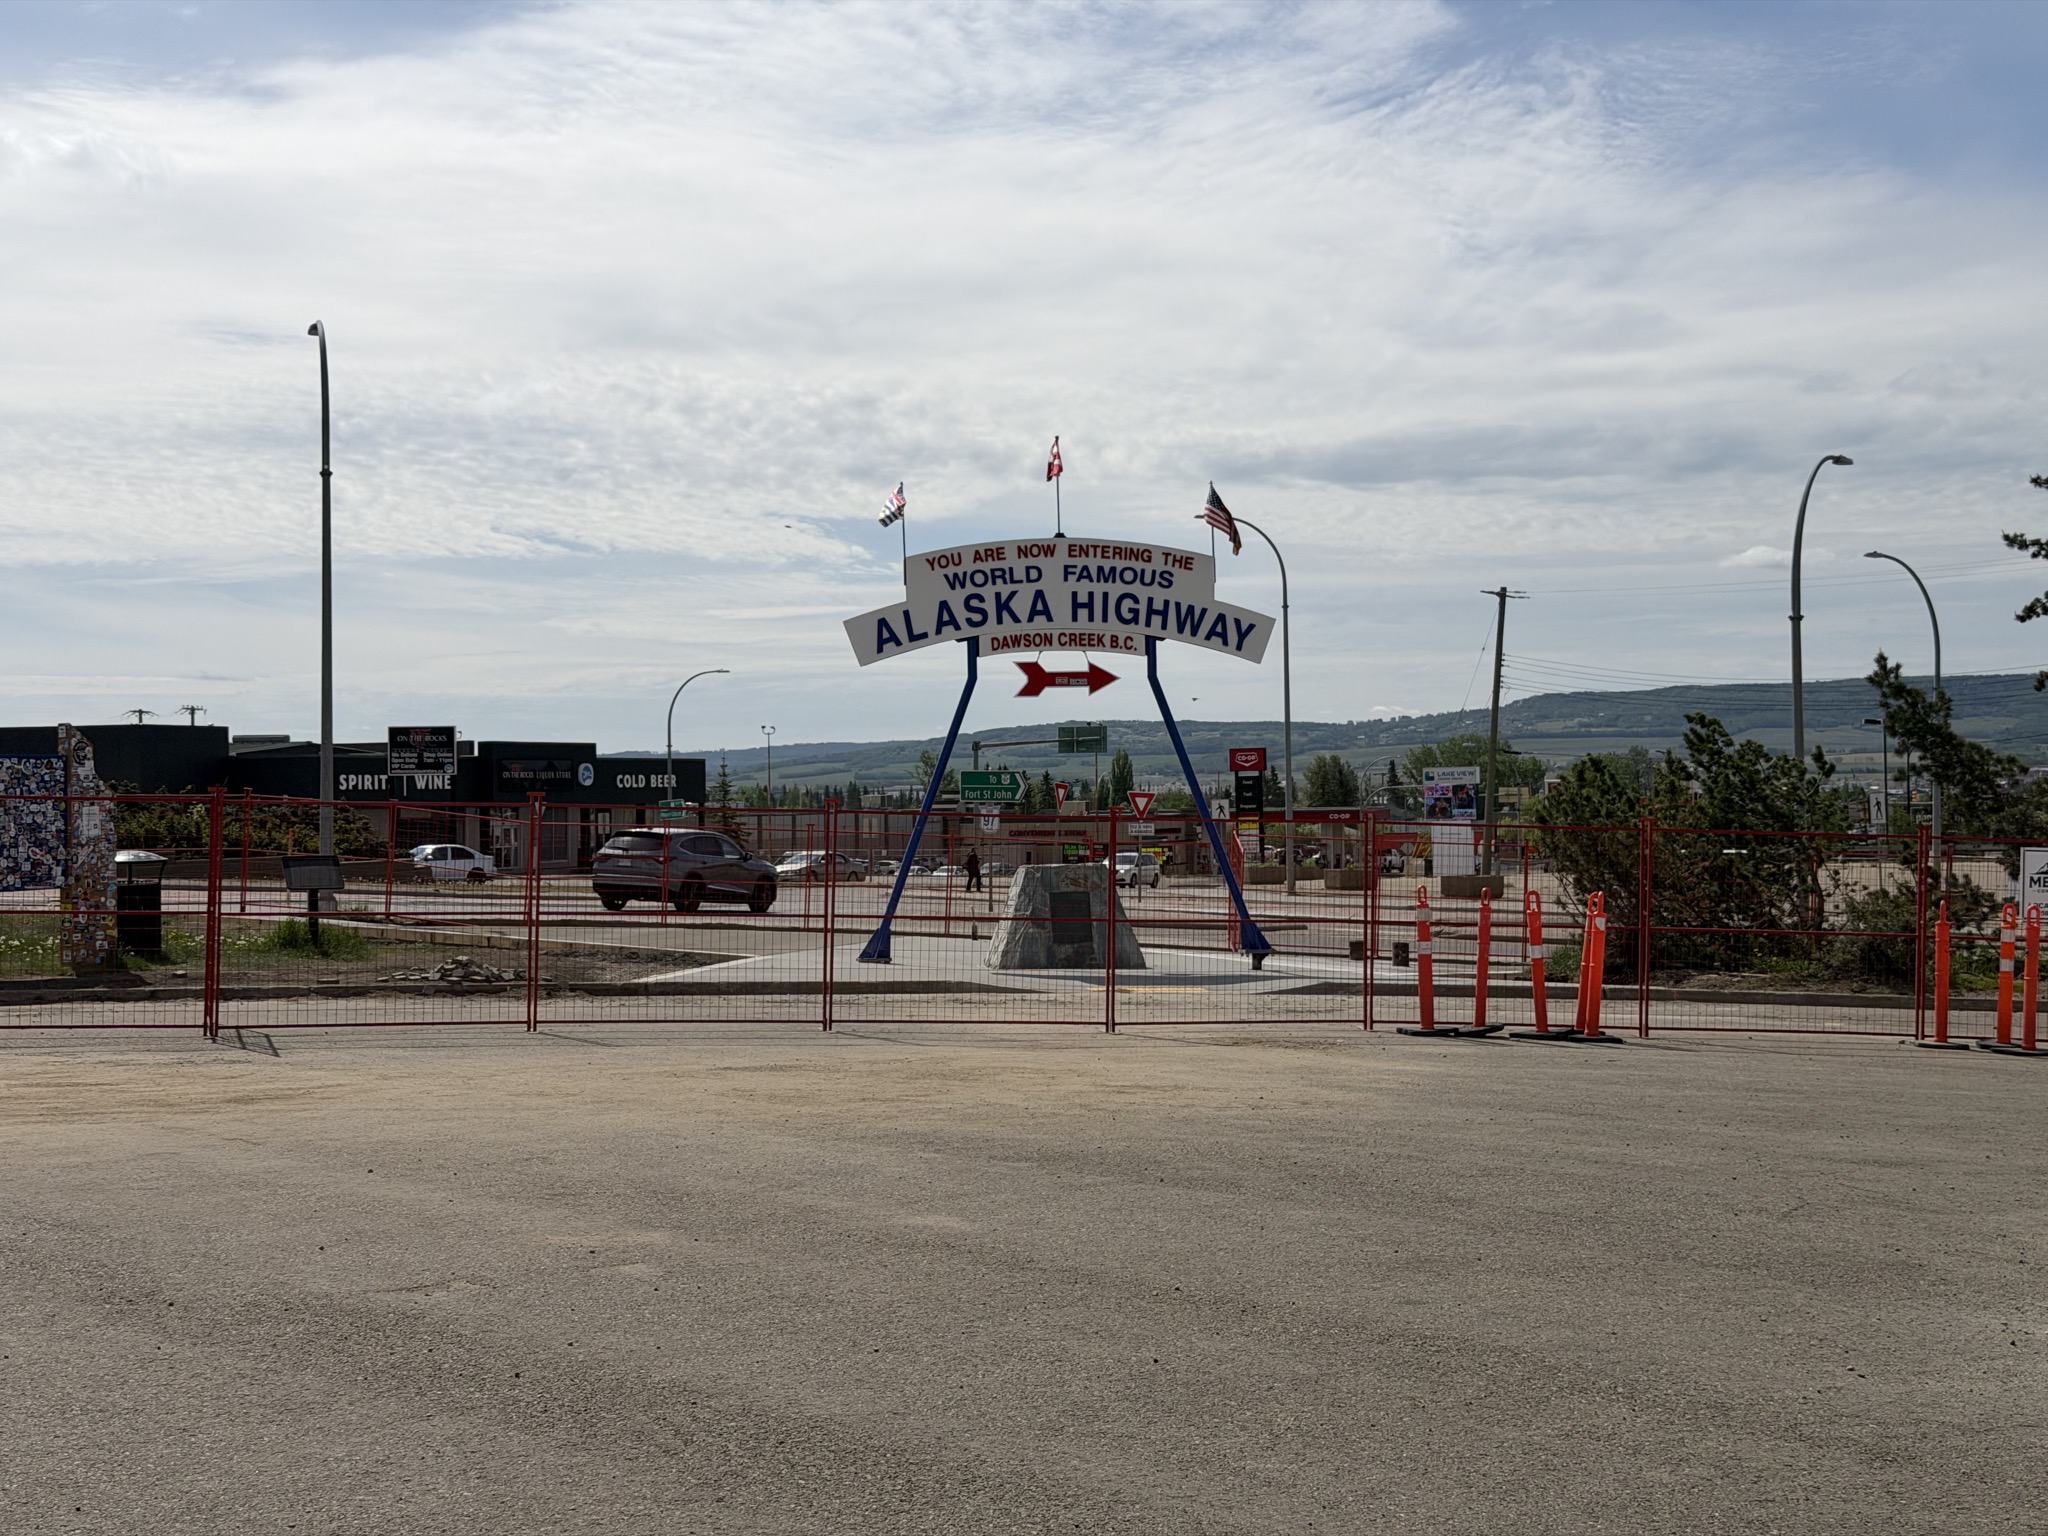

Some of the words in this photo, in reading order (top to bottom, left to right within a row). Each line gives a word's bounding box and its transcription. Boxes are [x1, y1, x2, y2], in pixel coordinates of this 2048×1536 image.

[926, 552, 962, 571] YOU
[973, 546, 1006, 564] ARE
[1017, 543, 1056, 559] NOW
[1068, 544, 1152, 563] ENTERING
[1162, 552, 1195, 571] THE
[943, 565, 1042, 591] WORLD
[1063, 564, 1175, 589] FAMOUS
[876, 589, 1054, 655] ALASKA
[1071, 591, 1257, 652] HIGHWAY
[991, 632, 1053, 651] DAWSON
[1058, 632, 1106, 648] CREEK
[1110, 634, 1137, 651] B.C.
[338, 774, 390, 791] SPIRIT
[414, 775, 452, 790] WINE
[616, 774, 645, 788] COLD
[650, 774, 677, 788] BEER
[989, 774, 997, 784] To
[965, 790, 981, 799] Fort
[983, 790, 991, 799] St
[993, 790, 1012, 799] John
